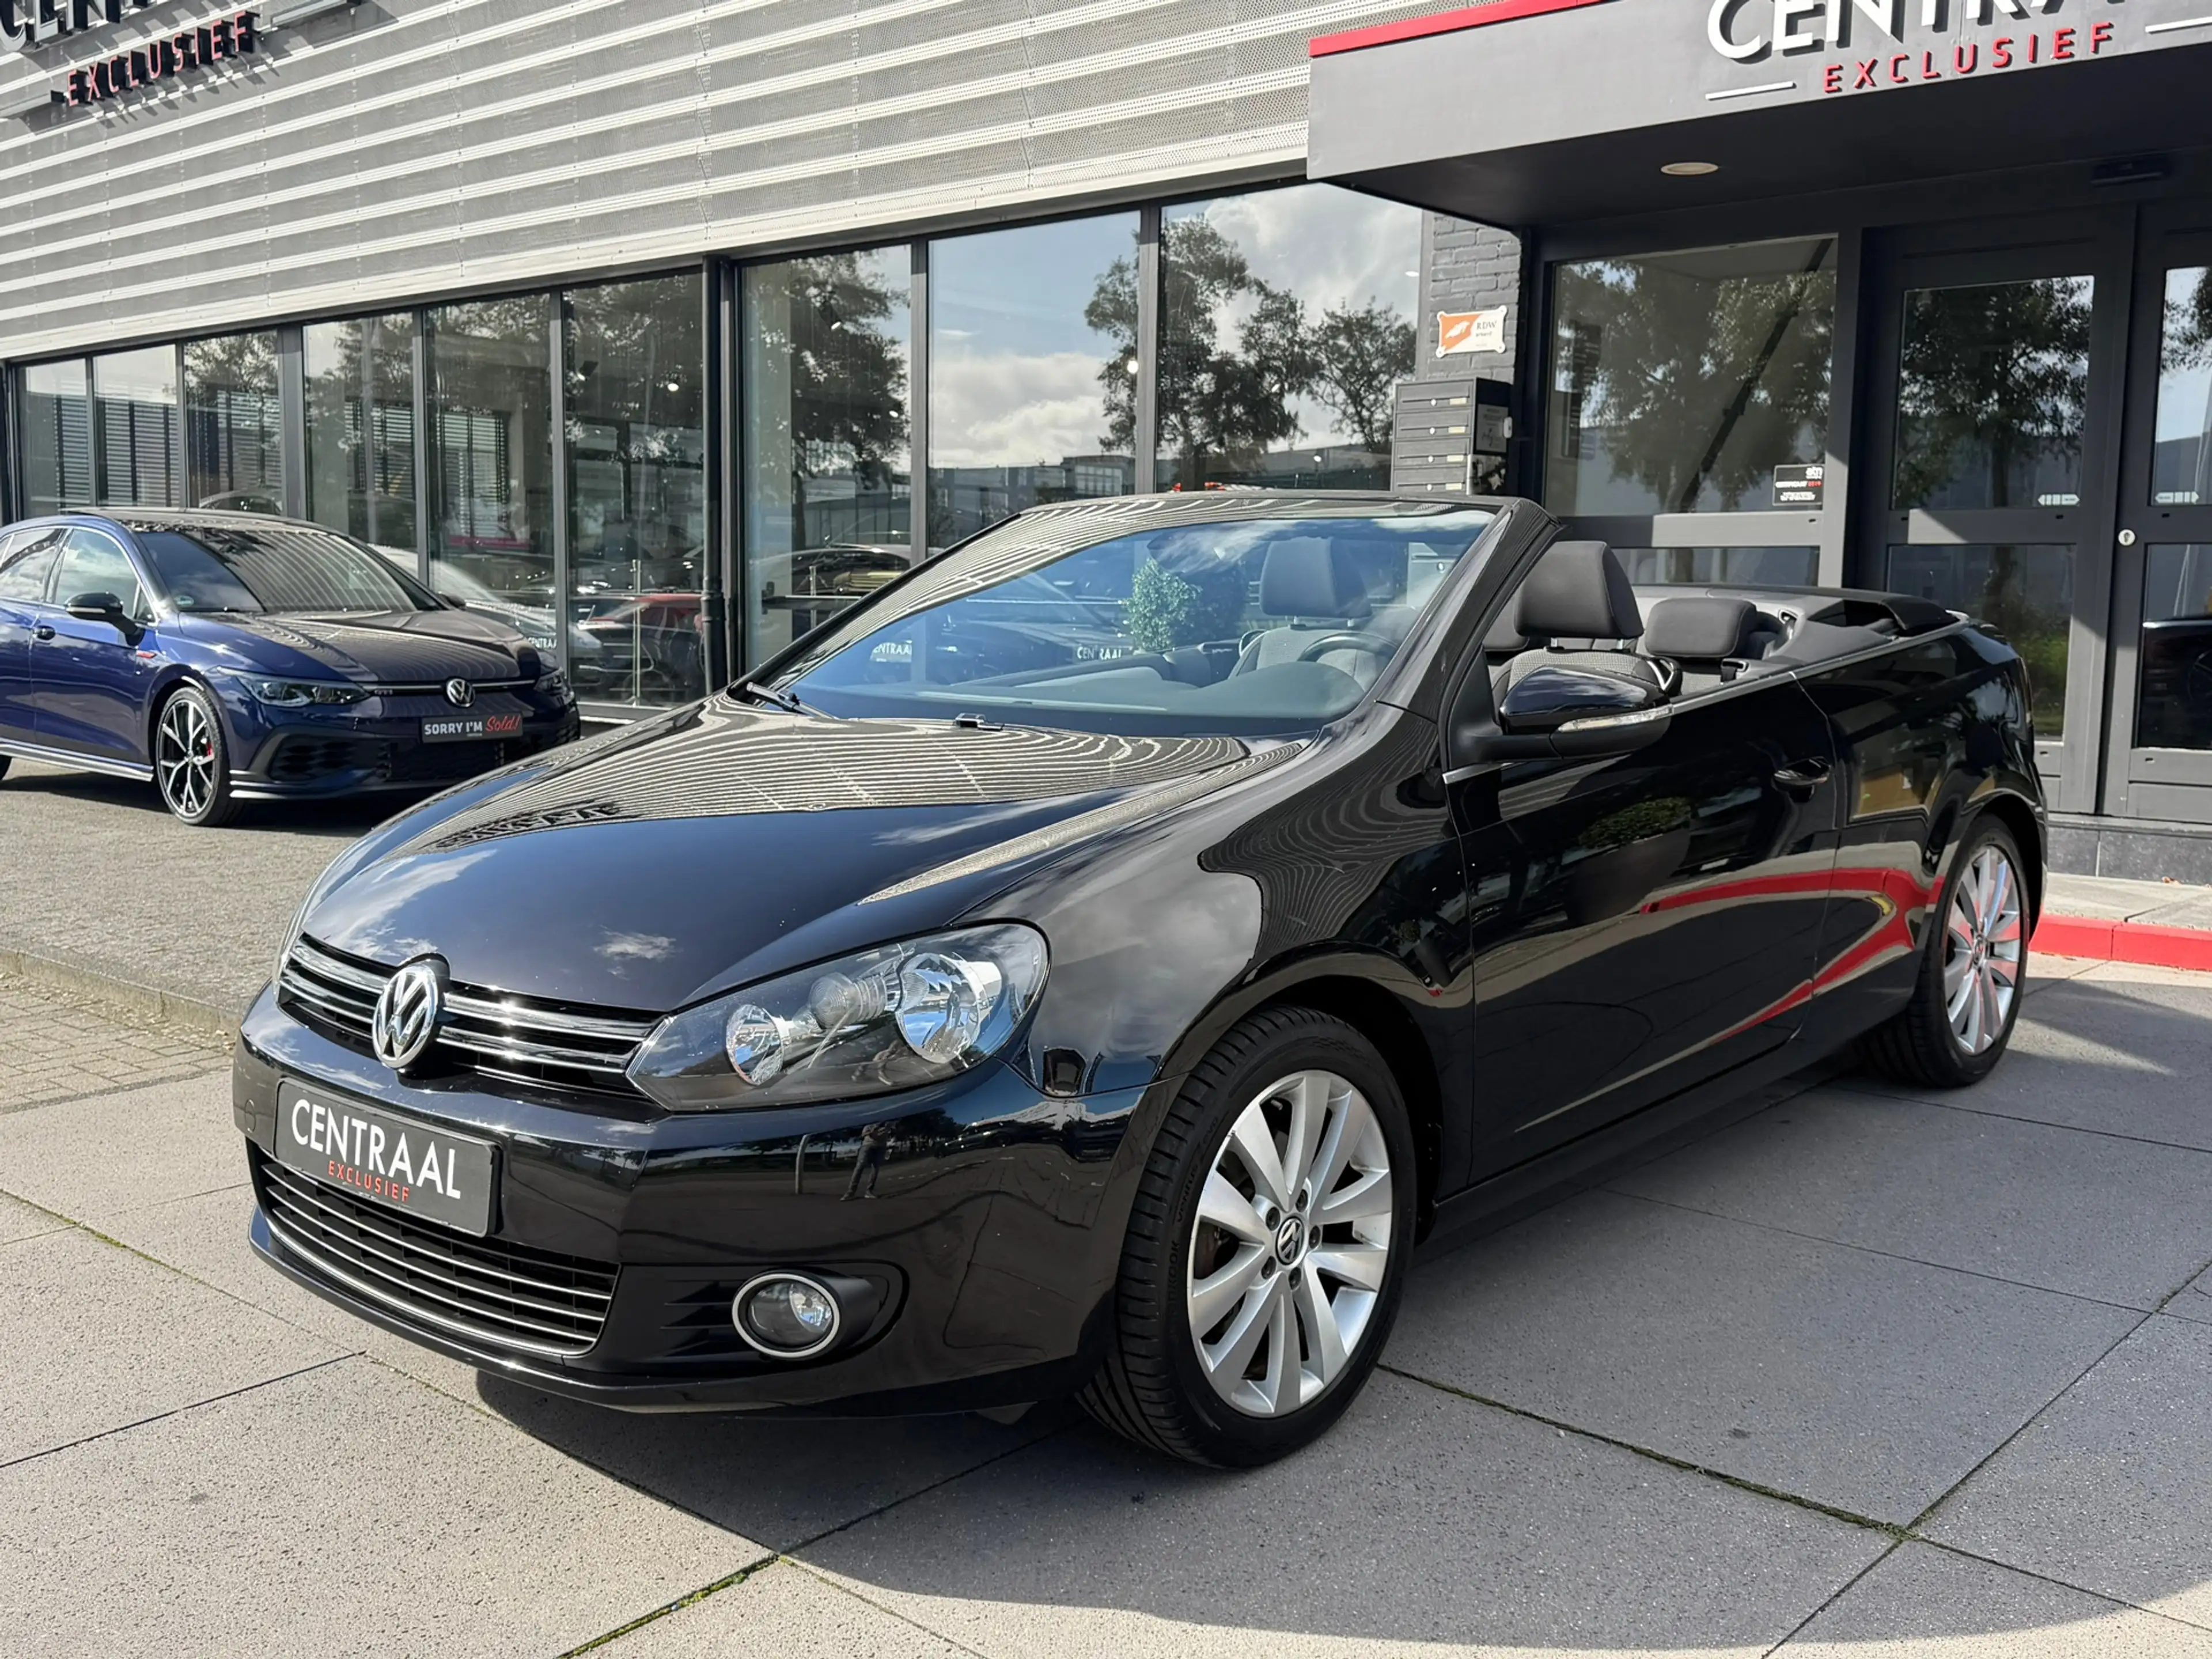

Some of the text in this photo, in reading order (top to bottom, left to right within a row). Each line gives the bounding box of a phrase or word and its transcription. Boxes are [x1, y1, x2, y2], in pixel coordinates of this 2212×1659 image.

[67, 10, 246, 106] EXCLUSIEF
[1823, 22, 2113, 93] EXCLUSIEF
[1476, 320, 1497, 330] RDW
[424, 714, 521, 736] SORRY I'M Sold!
[291, 1099, 461, 1200] CENTRAAL
[327, 1159, 411, 1203] EXCLUSIEF
